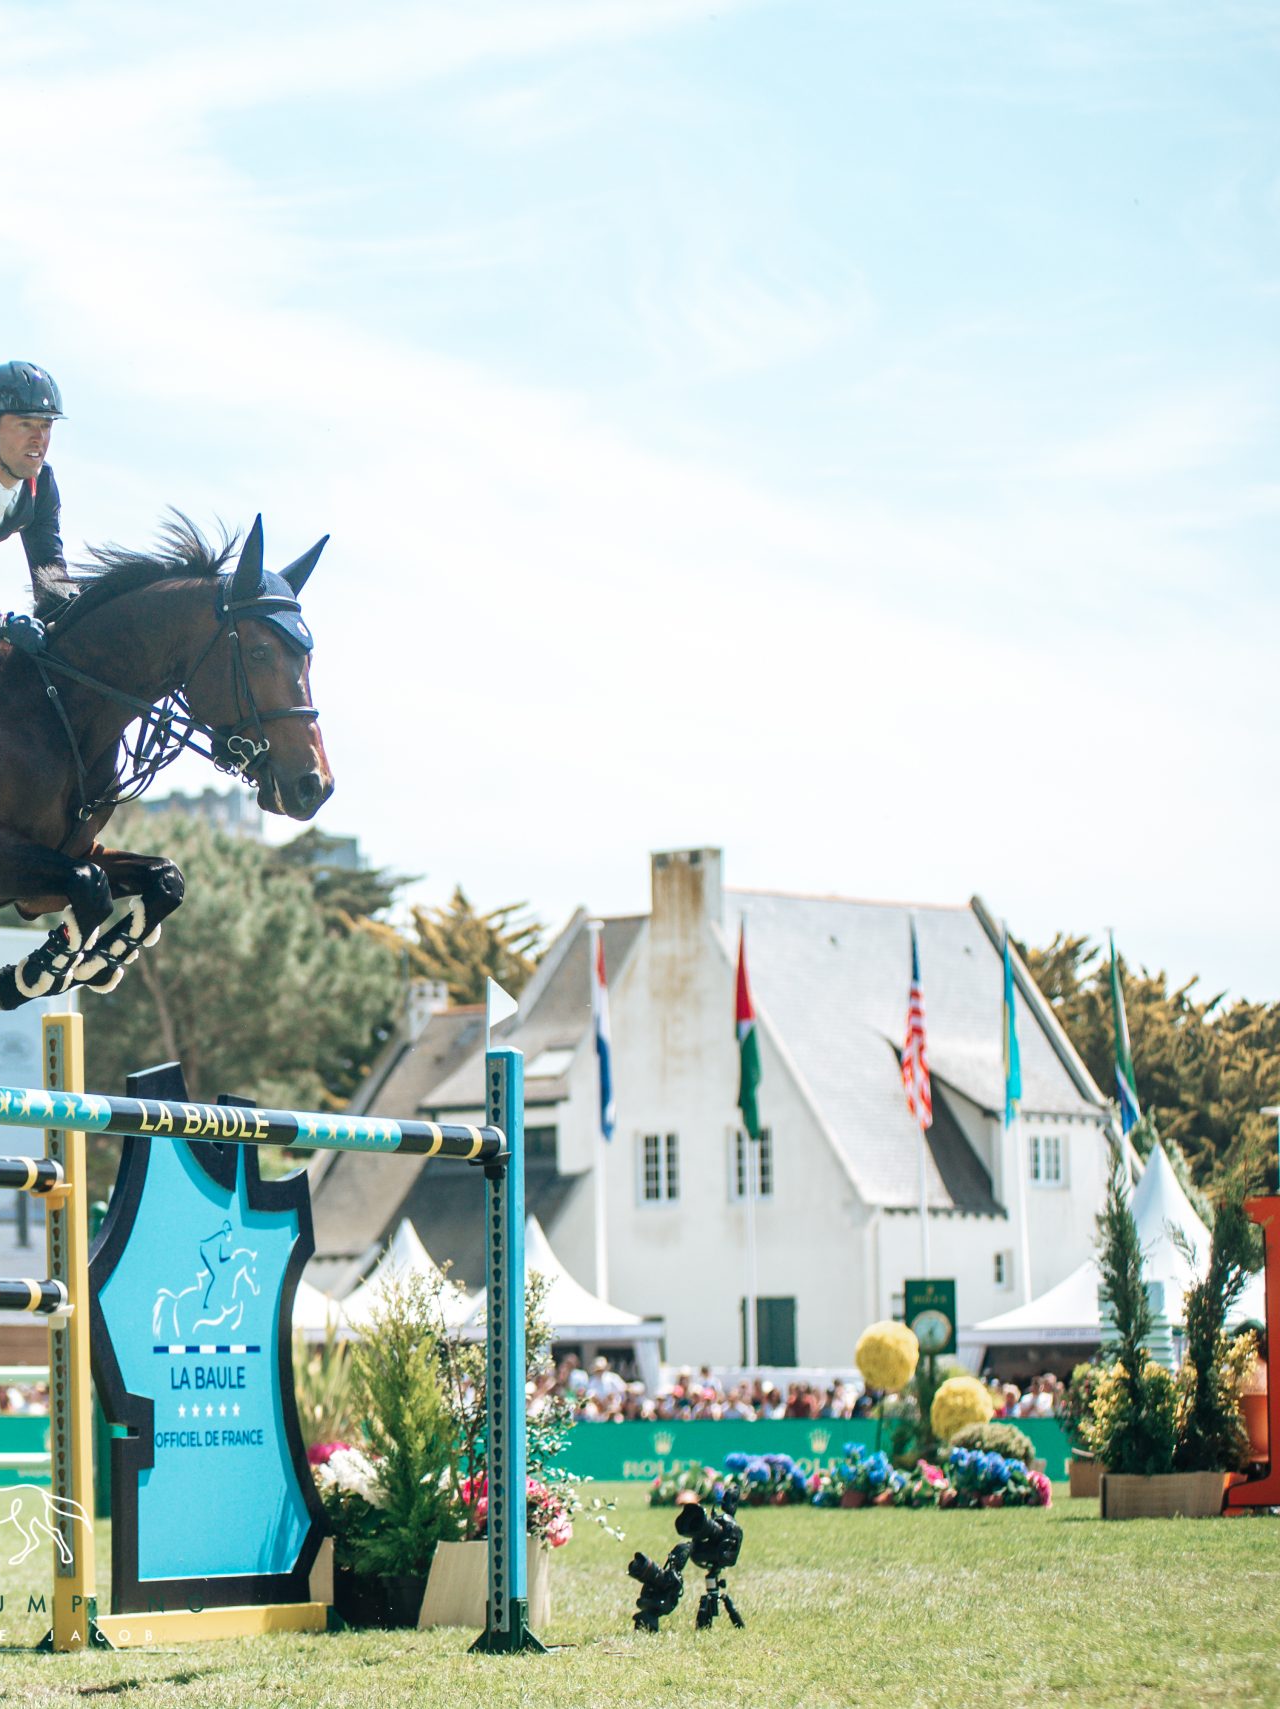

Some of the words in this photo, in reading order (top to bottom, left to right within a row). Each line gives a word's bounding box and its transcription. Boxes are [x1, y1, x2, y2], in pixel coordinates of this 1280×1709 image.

[137, 1101, 174, 1132] LA
[180, 1104, 269, 1138] BAULE
[170, 1366, 191, 1390] LA
[195, 1366, 246, 1390] BAULE
[154, 1431, 202, 1448] OFFICIEL
[205, 1430, 219, 1446] DE
[222, 1429, 264, 1446] FRANCE
